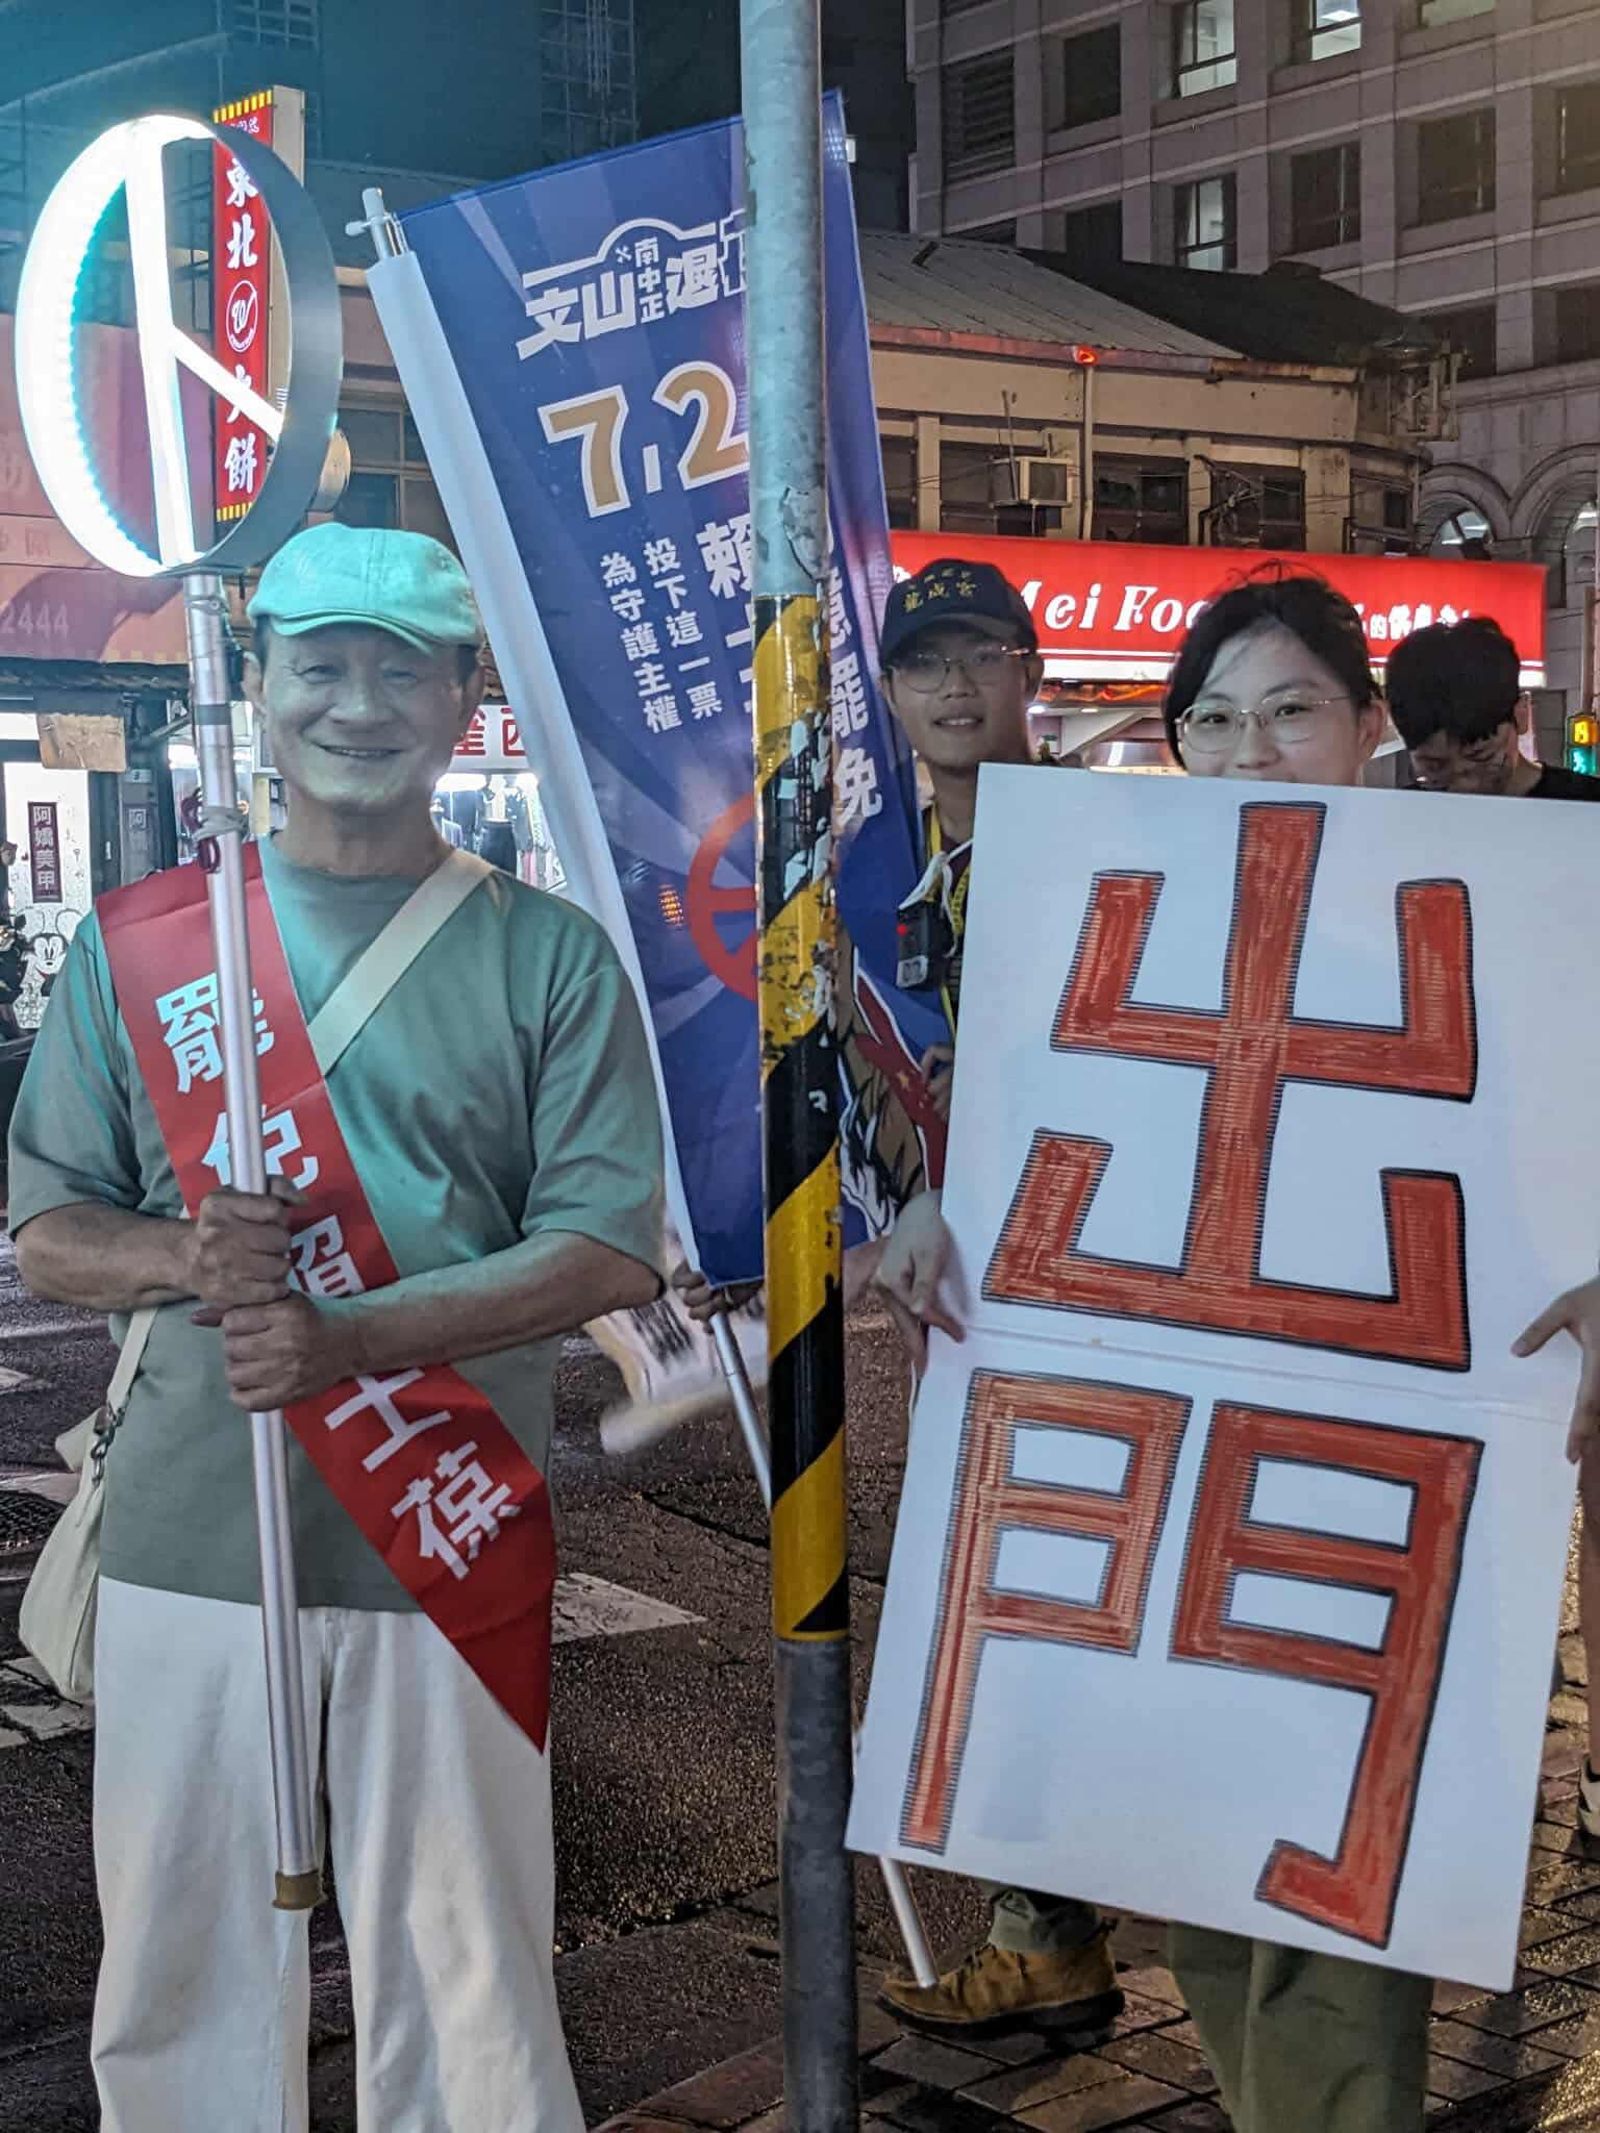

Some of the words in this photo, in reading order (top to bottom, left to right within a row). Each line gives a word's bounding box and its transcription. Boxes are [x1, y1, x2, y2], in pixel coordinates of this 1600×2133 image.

[515, 271, 637, 360] 文山
[600, 551, 683, 734] 為守護主權
[642, 536, 723, 721] 投下這一票
[898, 799, 1484, 1949] 出門
